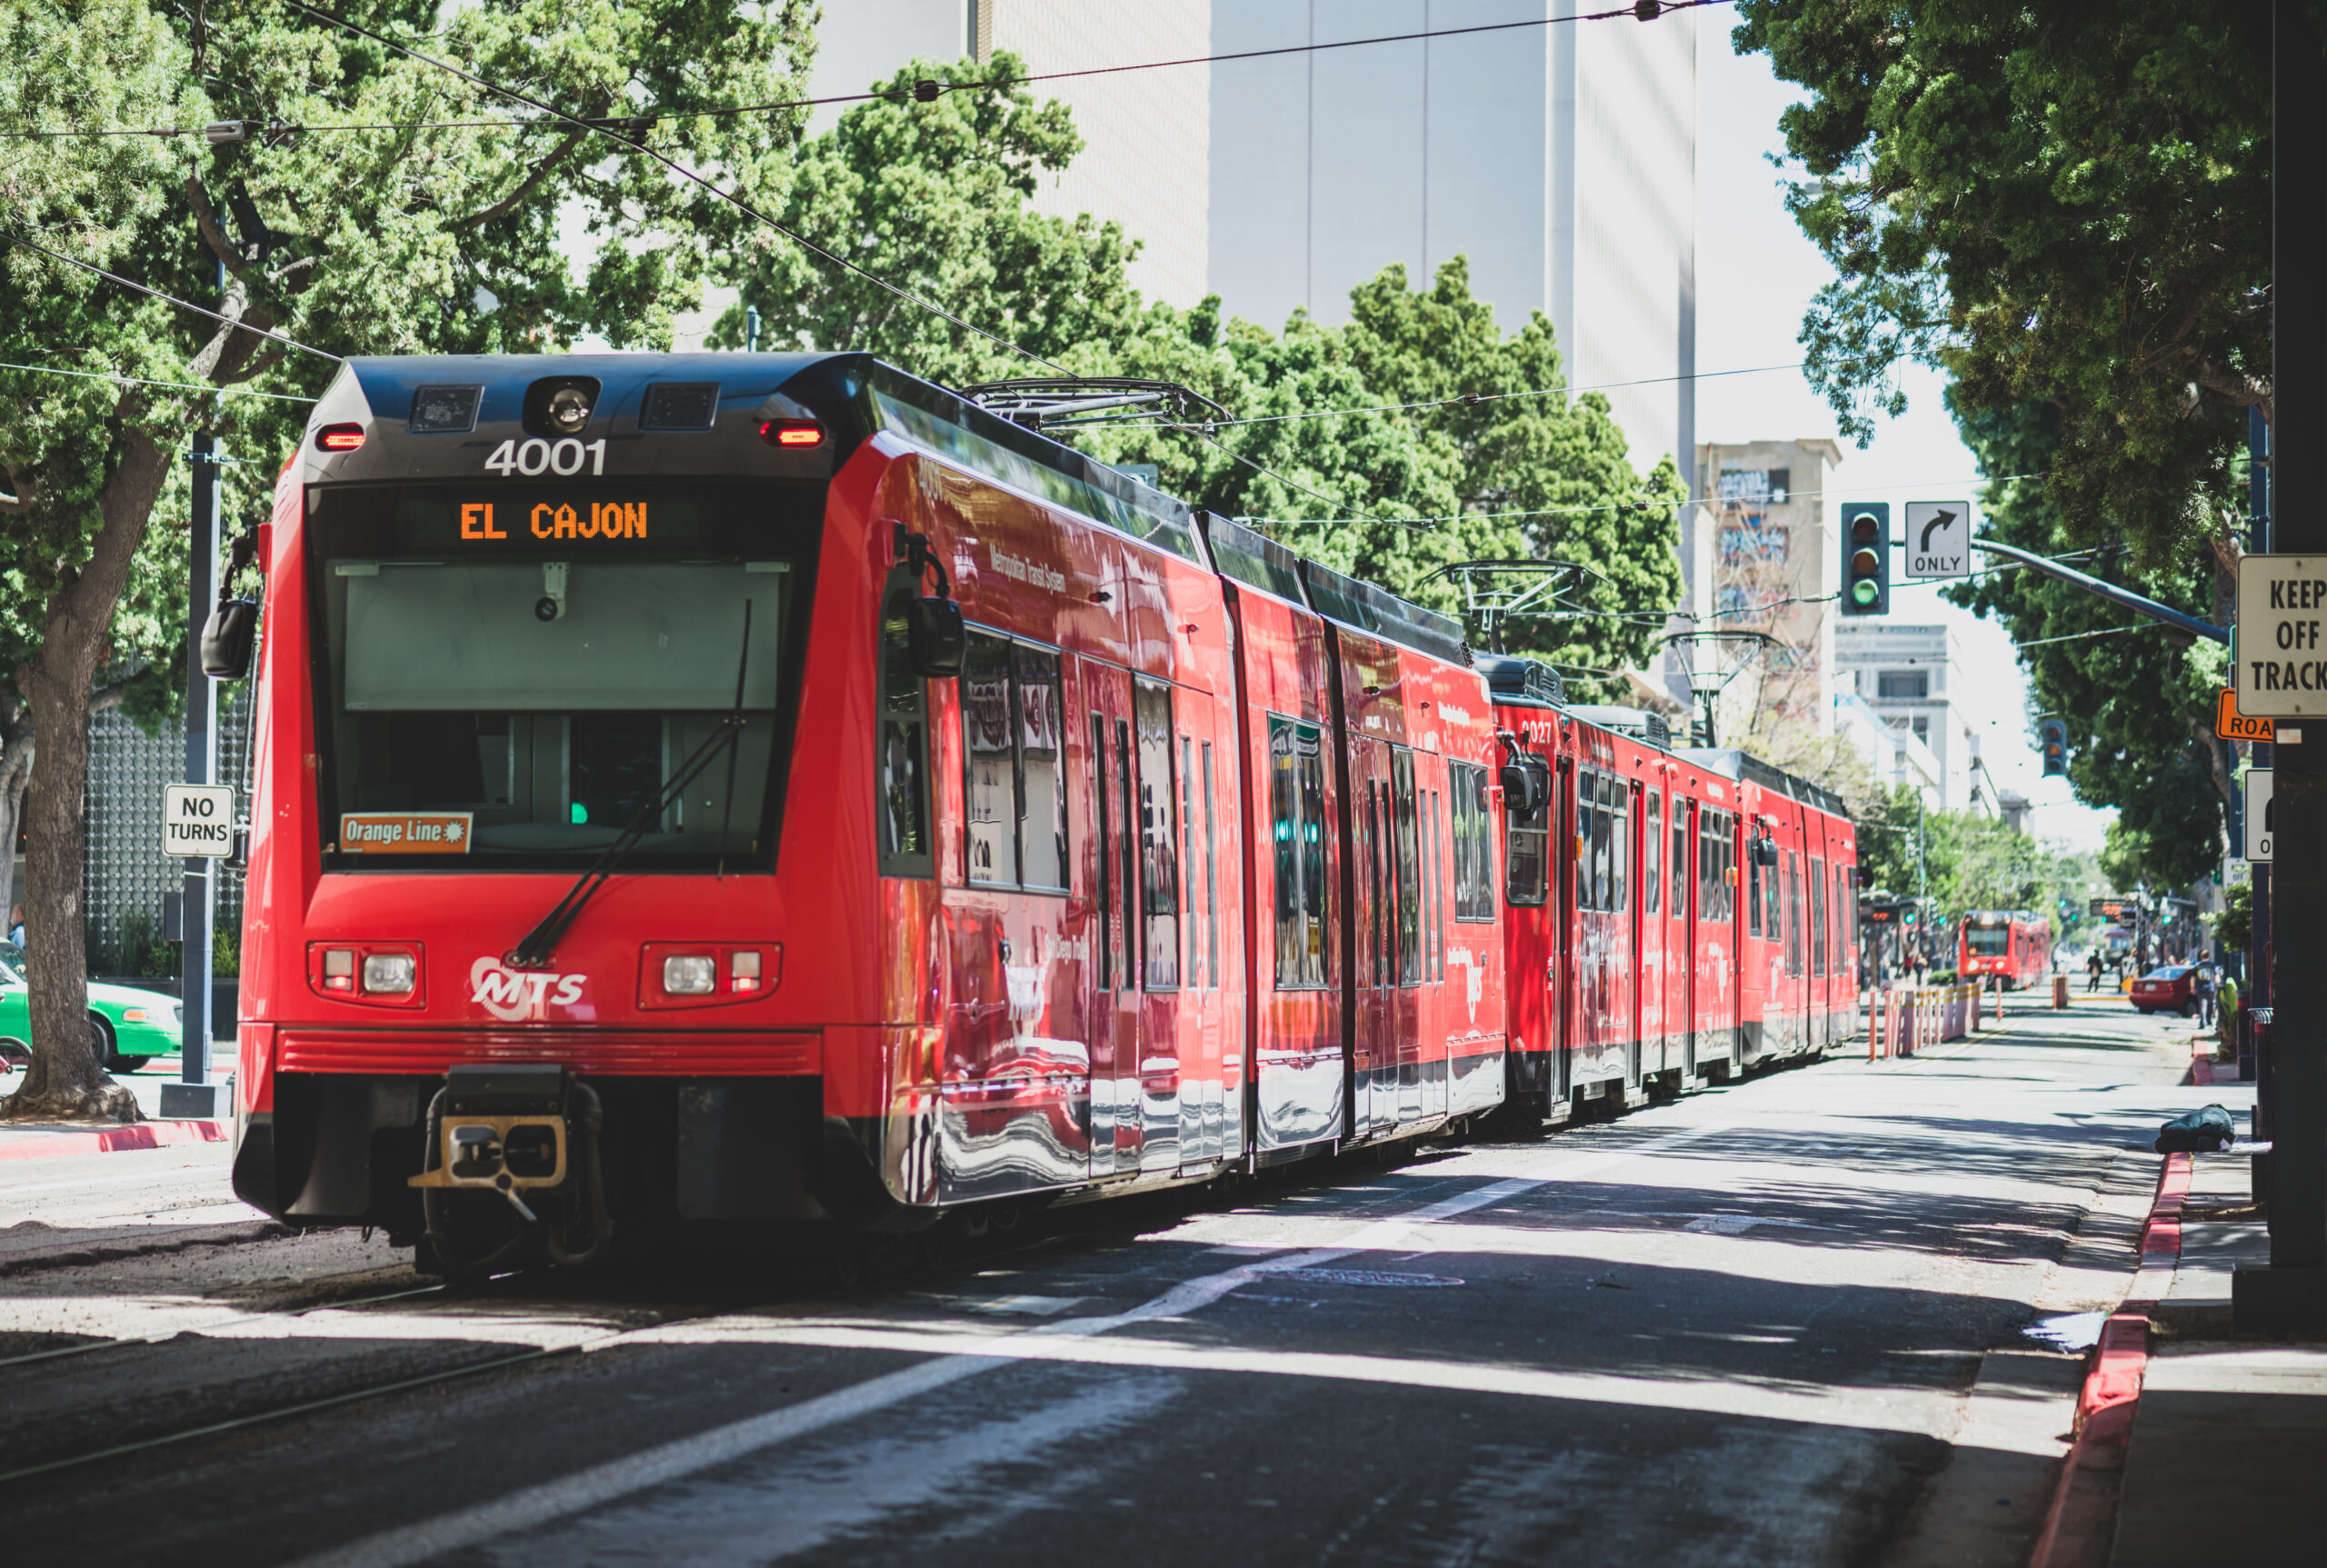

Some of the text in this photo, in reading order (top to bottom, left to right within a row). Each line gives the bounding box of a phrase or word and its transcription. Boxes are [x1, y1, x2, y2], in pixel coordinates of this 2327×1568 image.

[484, 438, 607, 476] 4001
[461, 502, 647, 539] EL CAJON
[1914, 556, 1961, 572] ONLY
[2271, 580, 2327, 609] KEEP
[2276, 621, 2320, 650] OFF
[183, 797, 215, 817] NO
[168, 823, 227, 841] TURNS
[346, 820, 442, 844] Orange Line
[471, 972, 588, 1005] MTS
